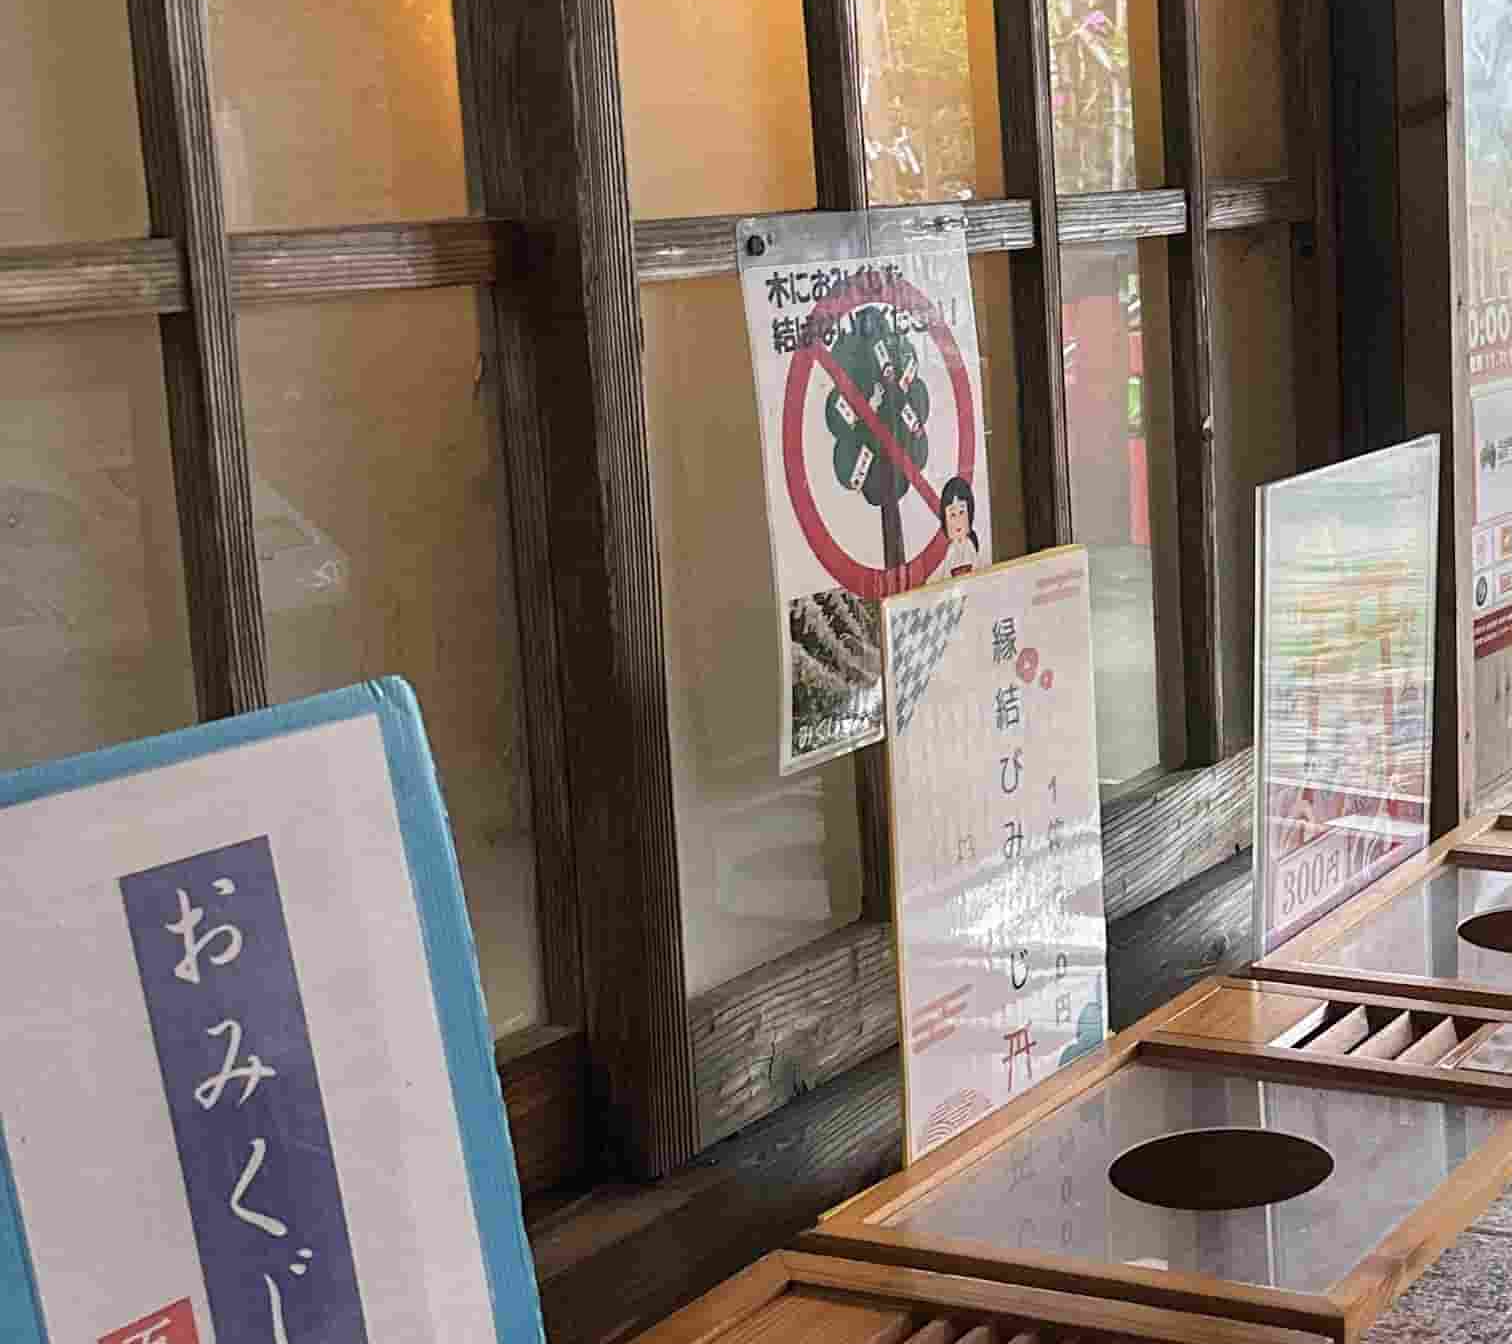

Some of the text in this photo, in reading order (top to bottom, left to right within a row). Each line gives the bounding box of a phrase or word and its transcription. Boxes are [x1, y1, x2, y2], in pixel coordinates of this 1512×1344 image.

[990, 616, 1031, 991] 縁結びみじ
